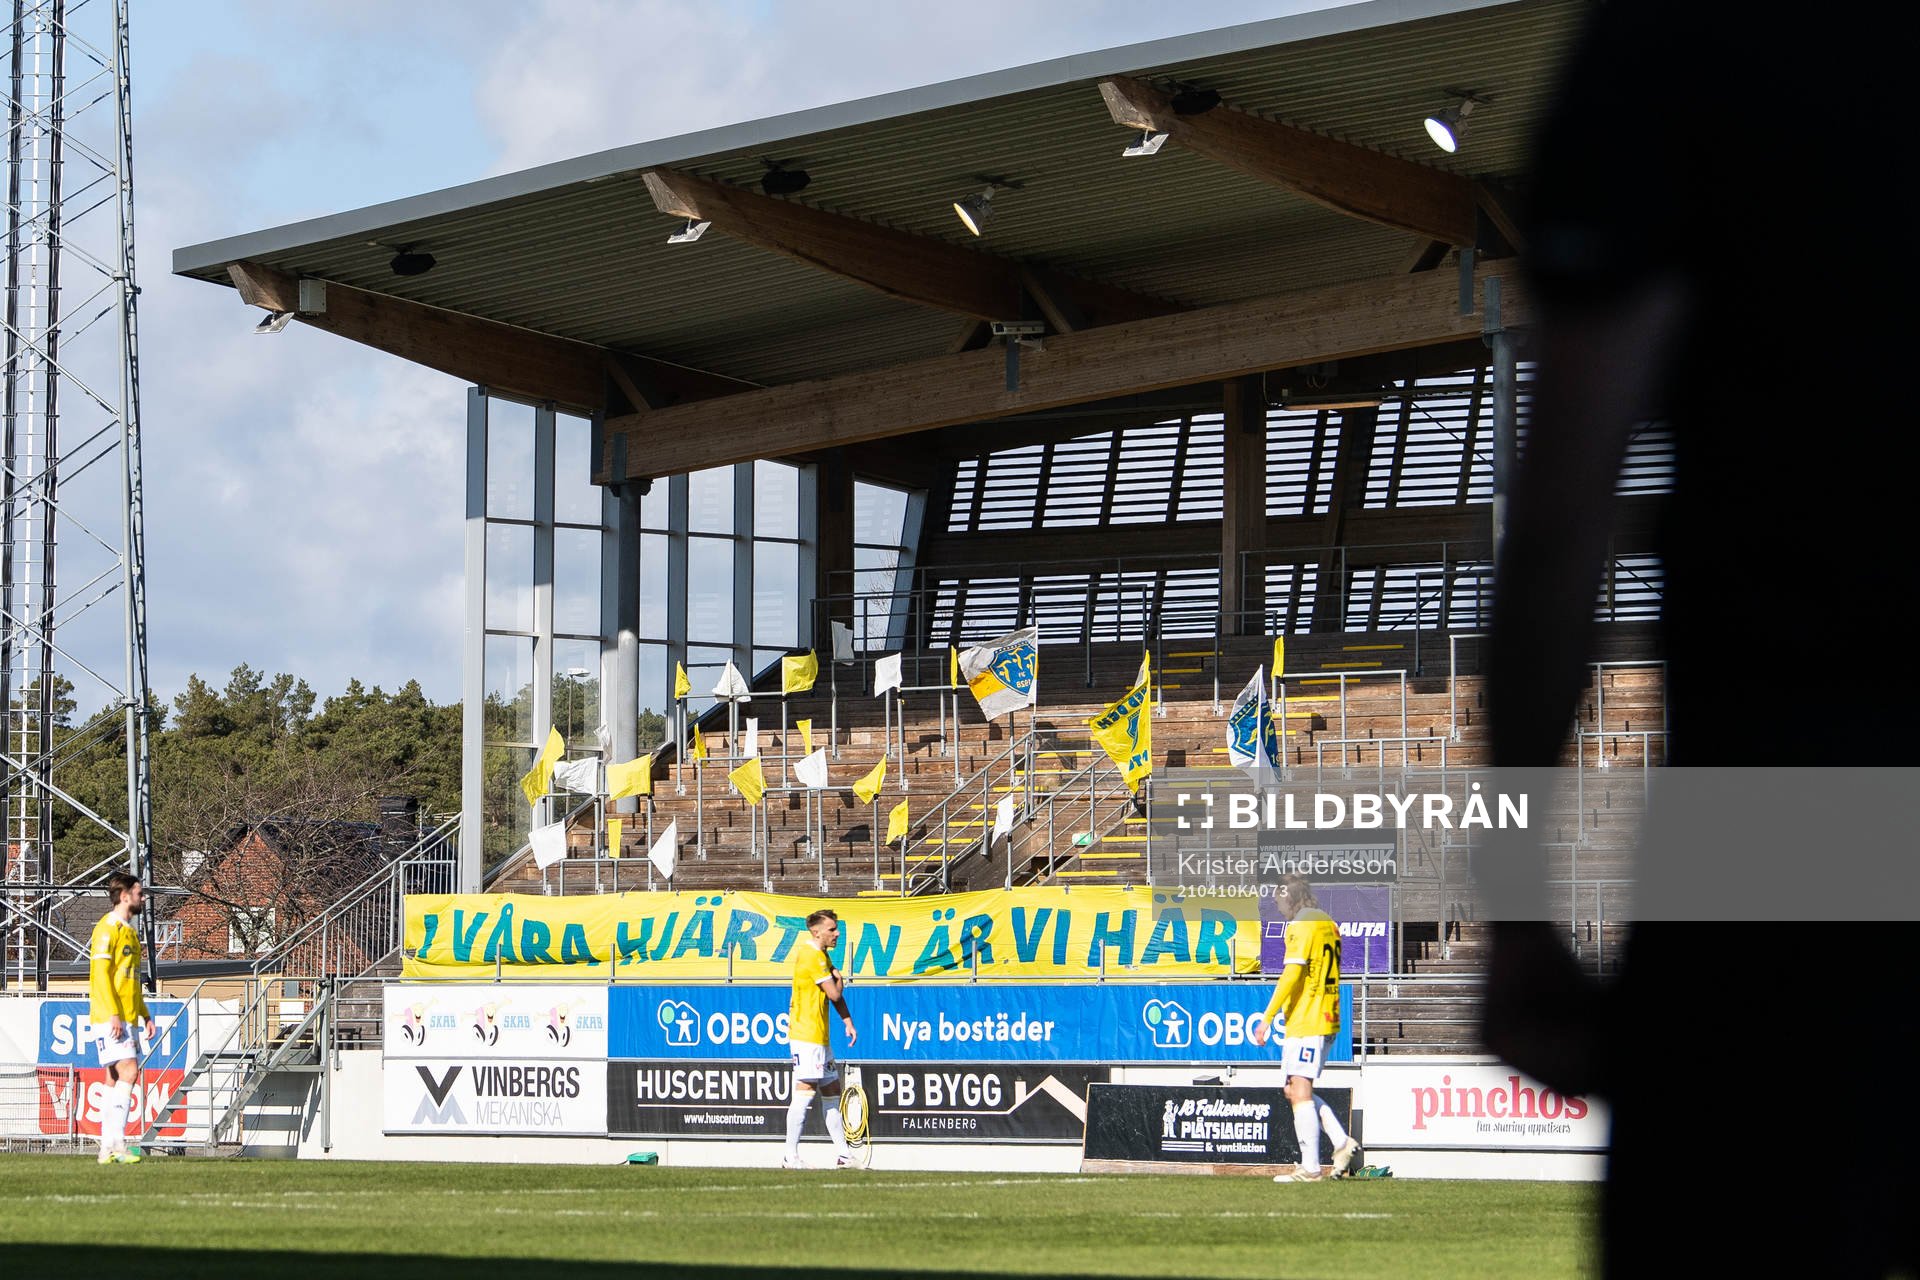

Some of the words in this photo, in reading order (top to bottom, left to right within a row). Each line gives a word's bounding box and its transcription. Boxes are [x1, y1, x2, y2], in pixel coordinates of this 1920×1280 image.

[418, 914, 439, 959] I
[453, 902, 600, 966] VÅRA
[913, 908, 994, 975] ÄR
[1011, 906, 1071, 965] VI
[1087, 893, 1237, 966] HÄR
[50, 1014, 177, 1056] SPRT
[430, 1015, 456, 1028] SKAB
[503, 1015, 530, 1029] SKAB
[576, 1016, 603, 1029] SKAB
[707, 1012, 790, 1045] OBOS
[882, 1013, 931, 1050] Nya
[939, 1012, 1055, 1043] bostäder
[1198, 1012, 1287, 1046] OBOS
[472, 1066, 580, 1098] VINBERGS
[637, 1069, 791, 1100] HUSCENTRU
[877, 1073, 915, 1106] PB
[924, 1073, 1002, 1107] BYGG
[45, 1080, 172, 1123] VISON
[476, 1101, 563, 1126] MEKANISKA
[1196, 1098, 1270, 1120] Falkenbergs
[1411, 1075, 1588, 1130] pinchos
[684, 1112, 765, 1125] www.huscentrum.se
[902, 1118, 977, 1129] FALKENBERG
[1180, 1116, 1268, 1140] PLÅTSLAGERI
[1528, 1121, 1571, 1136] appetizers
[1205, 1142, 1214, 1152] &
[1216, 1142, 1266, 1153] ventilation
